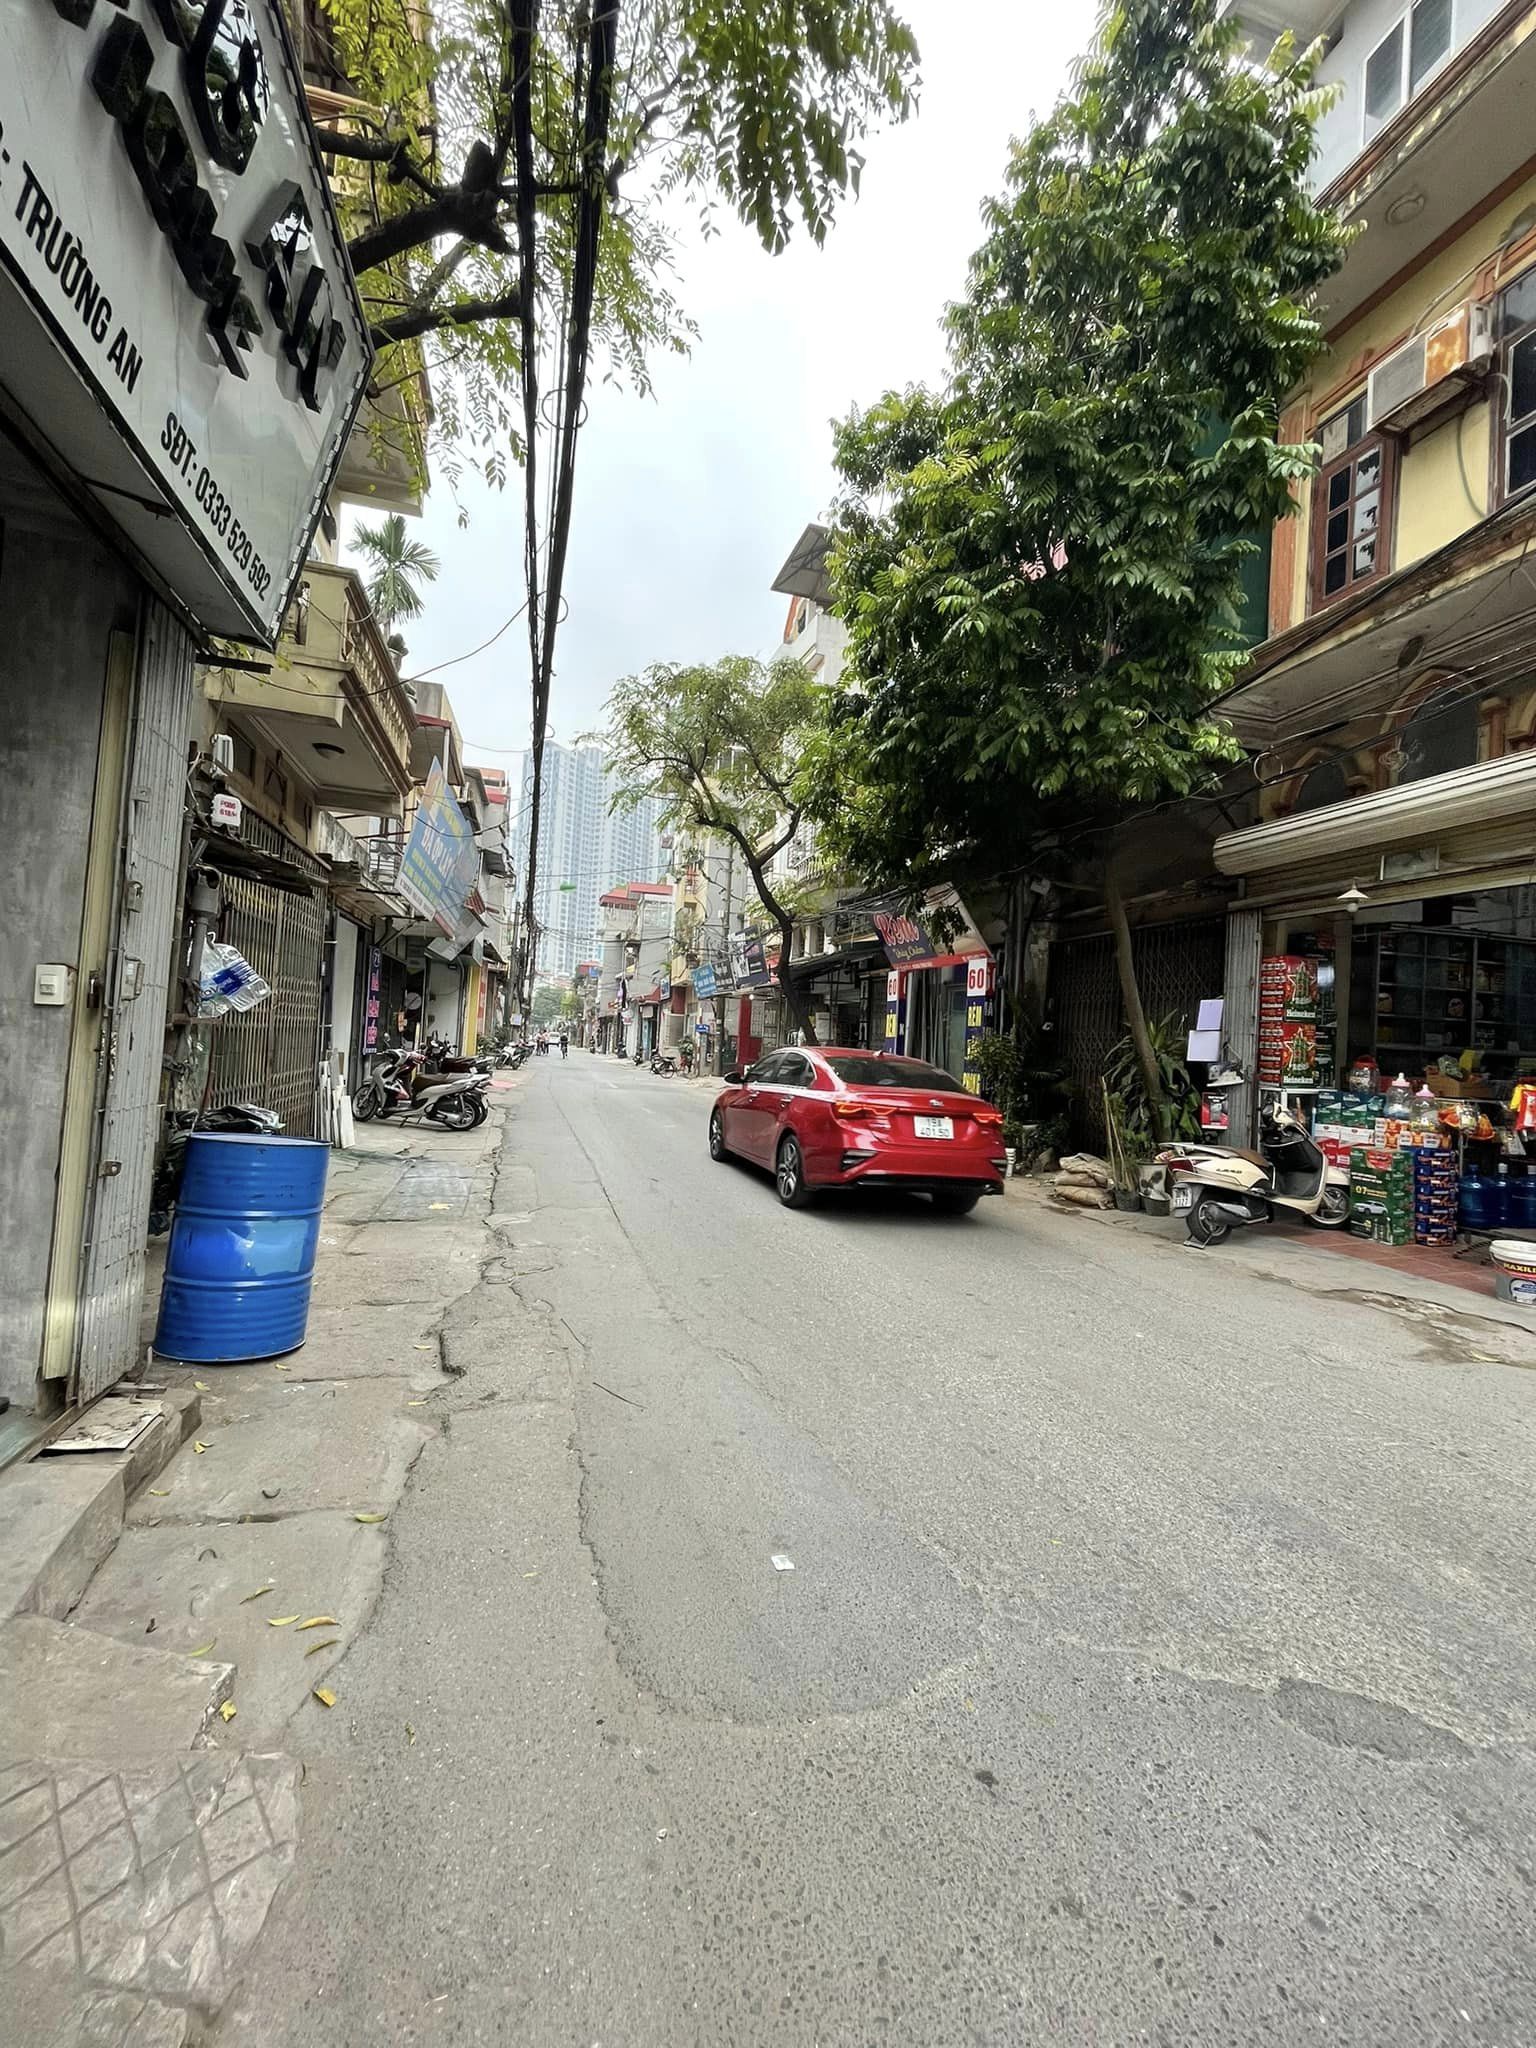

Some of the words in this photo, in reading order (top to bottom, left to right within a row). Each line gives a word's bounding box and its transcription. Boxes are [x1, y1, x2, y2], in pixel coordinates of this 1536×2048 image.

[243, 178, 347, 412] AN
[15, 160, 113, 343] TRƯỜNG
[106, 331, 143, 396] AN
[160, 411, 199, 488] SĐT:
[194, 473, 233, 542] 0333
[226, 517, 254, 571] 529
[248, 550, 272, 603] 592
[887, 978, 897, 995] 60
[968, 967, 985, 990] 60
